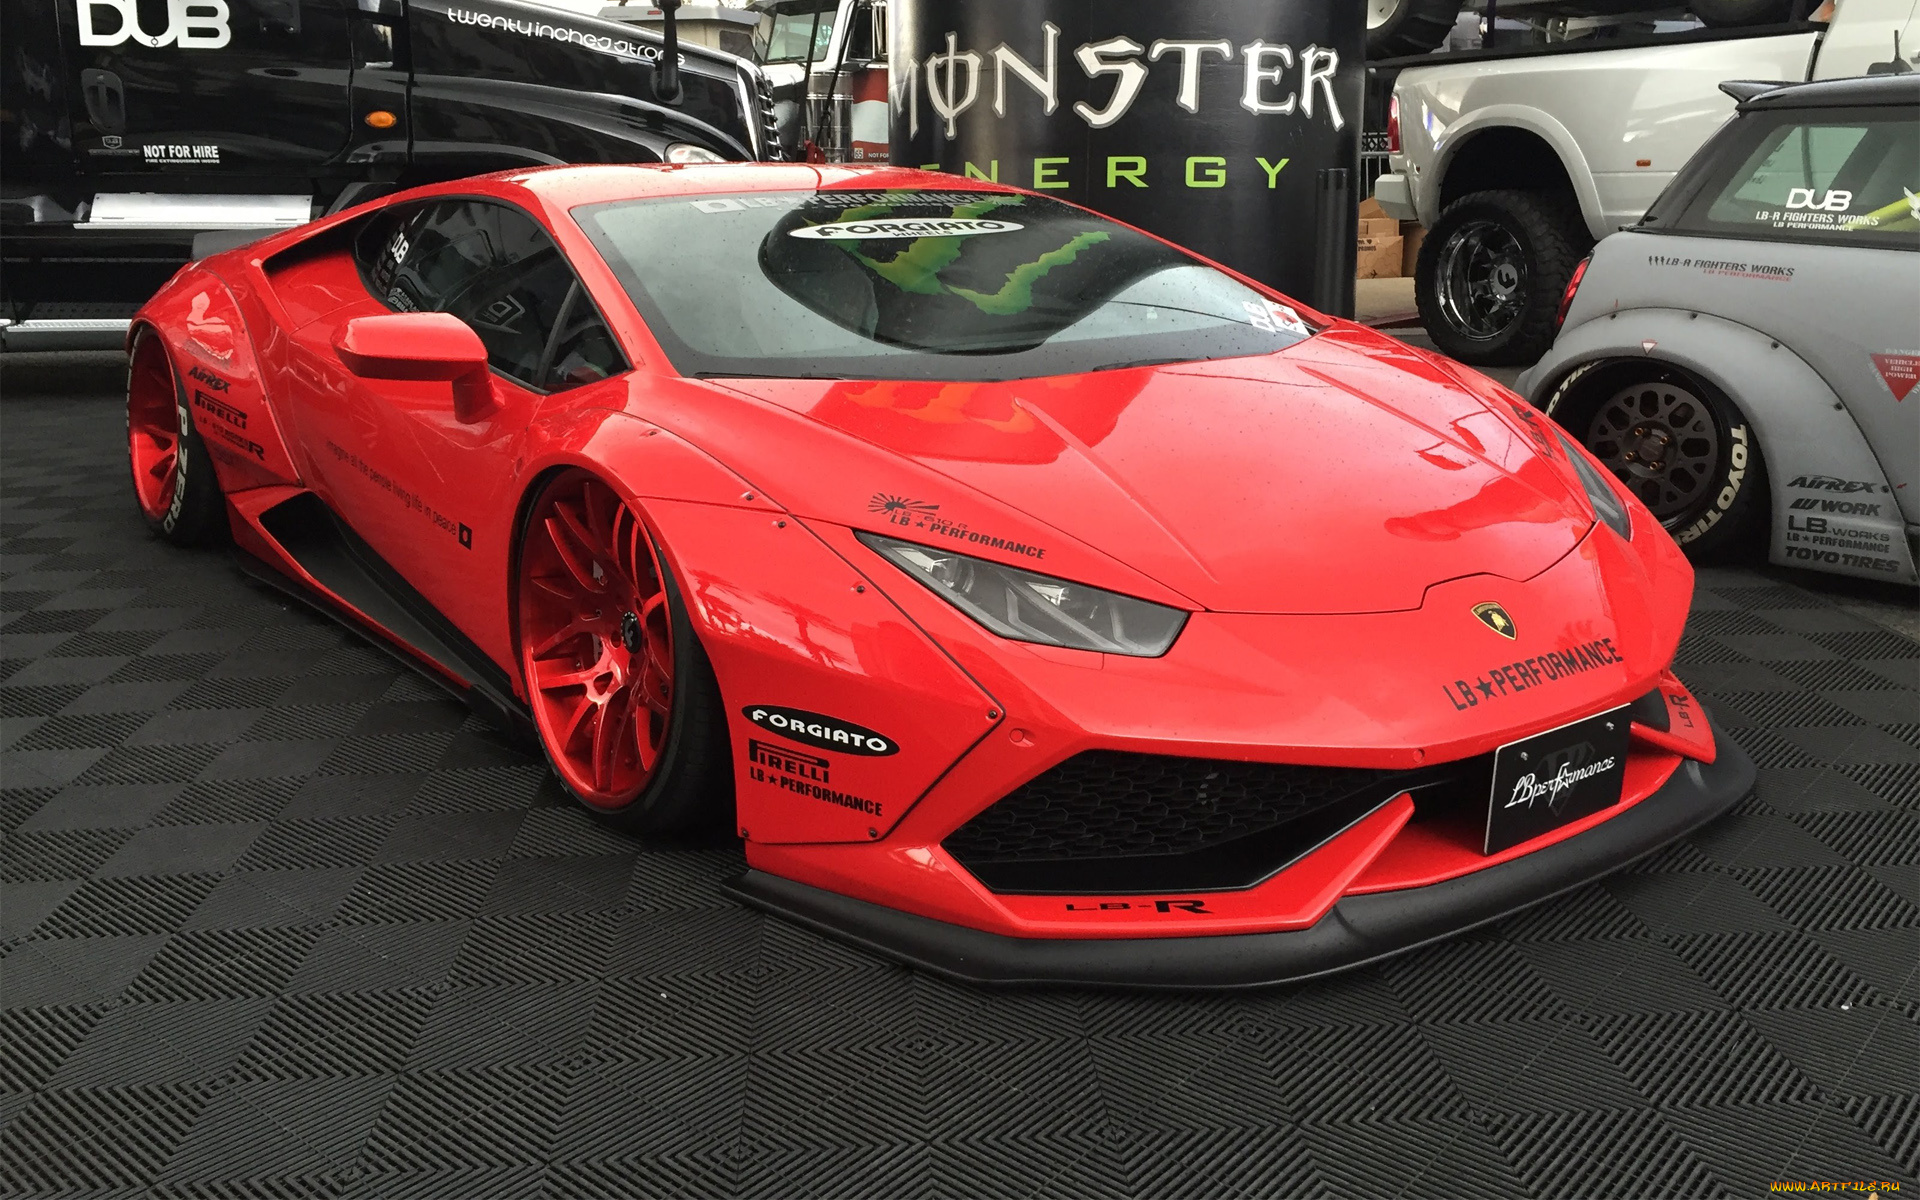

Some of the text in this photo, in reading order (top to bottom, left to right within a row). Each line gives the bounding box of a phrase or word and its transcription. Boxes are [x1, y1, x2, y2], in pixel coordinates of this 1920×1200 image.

[76, 0, 231, 49] DUB
[448, 8, 531, 36] twenty
[535, 22, 612, 48] inches
[143, 145, 165, 158] NOT
[168, 145, 191, 158] FOR
[192, 145, 219, 158] HIRE
[920, 157, 1290, 189] NERGY
[1785, 188, 1853, 212] DUB
[815, 221, 1005, 236] FORGIATO
[1756, 211, 1880, 226] LB-R FIGHTERS WORKS
[1787, 222, 1854, 231] PERFORMANCE
[1666, 257, 1795, 277] LB-R FIGHTERS WORKS
[194, 389, 248, 430] PIRELLI
[1716, 424, 1748, 510] TOYO
[890, 513, 1047, 559] LB PERFORMANCE
[1787, 532, 1890, 553] LB PERFORMANCE
[1785, 546, 1900, 573] TOYO TIRES
[1489, 638, 1624, 697] PERFORMANCE
[752, 709, 888, 752] FORGIATO
[749, 738, 830, 783] PIRELLI
[750, 766, 883, 816] LB PERFORMANCE
